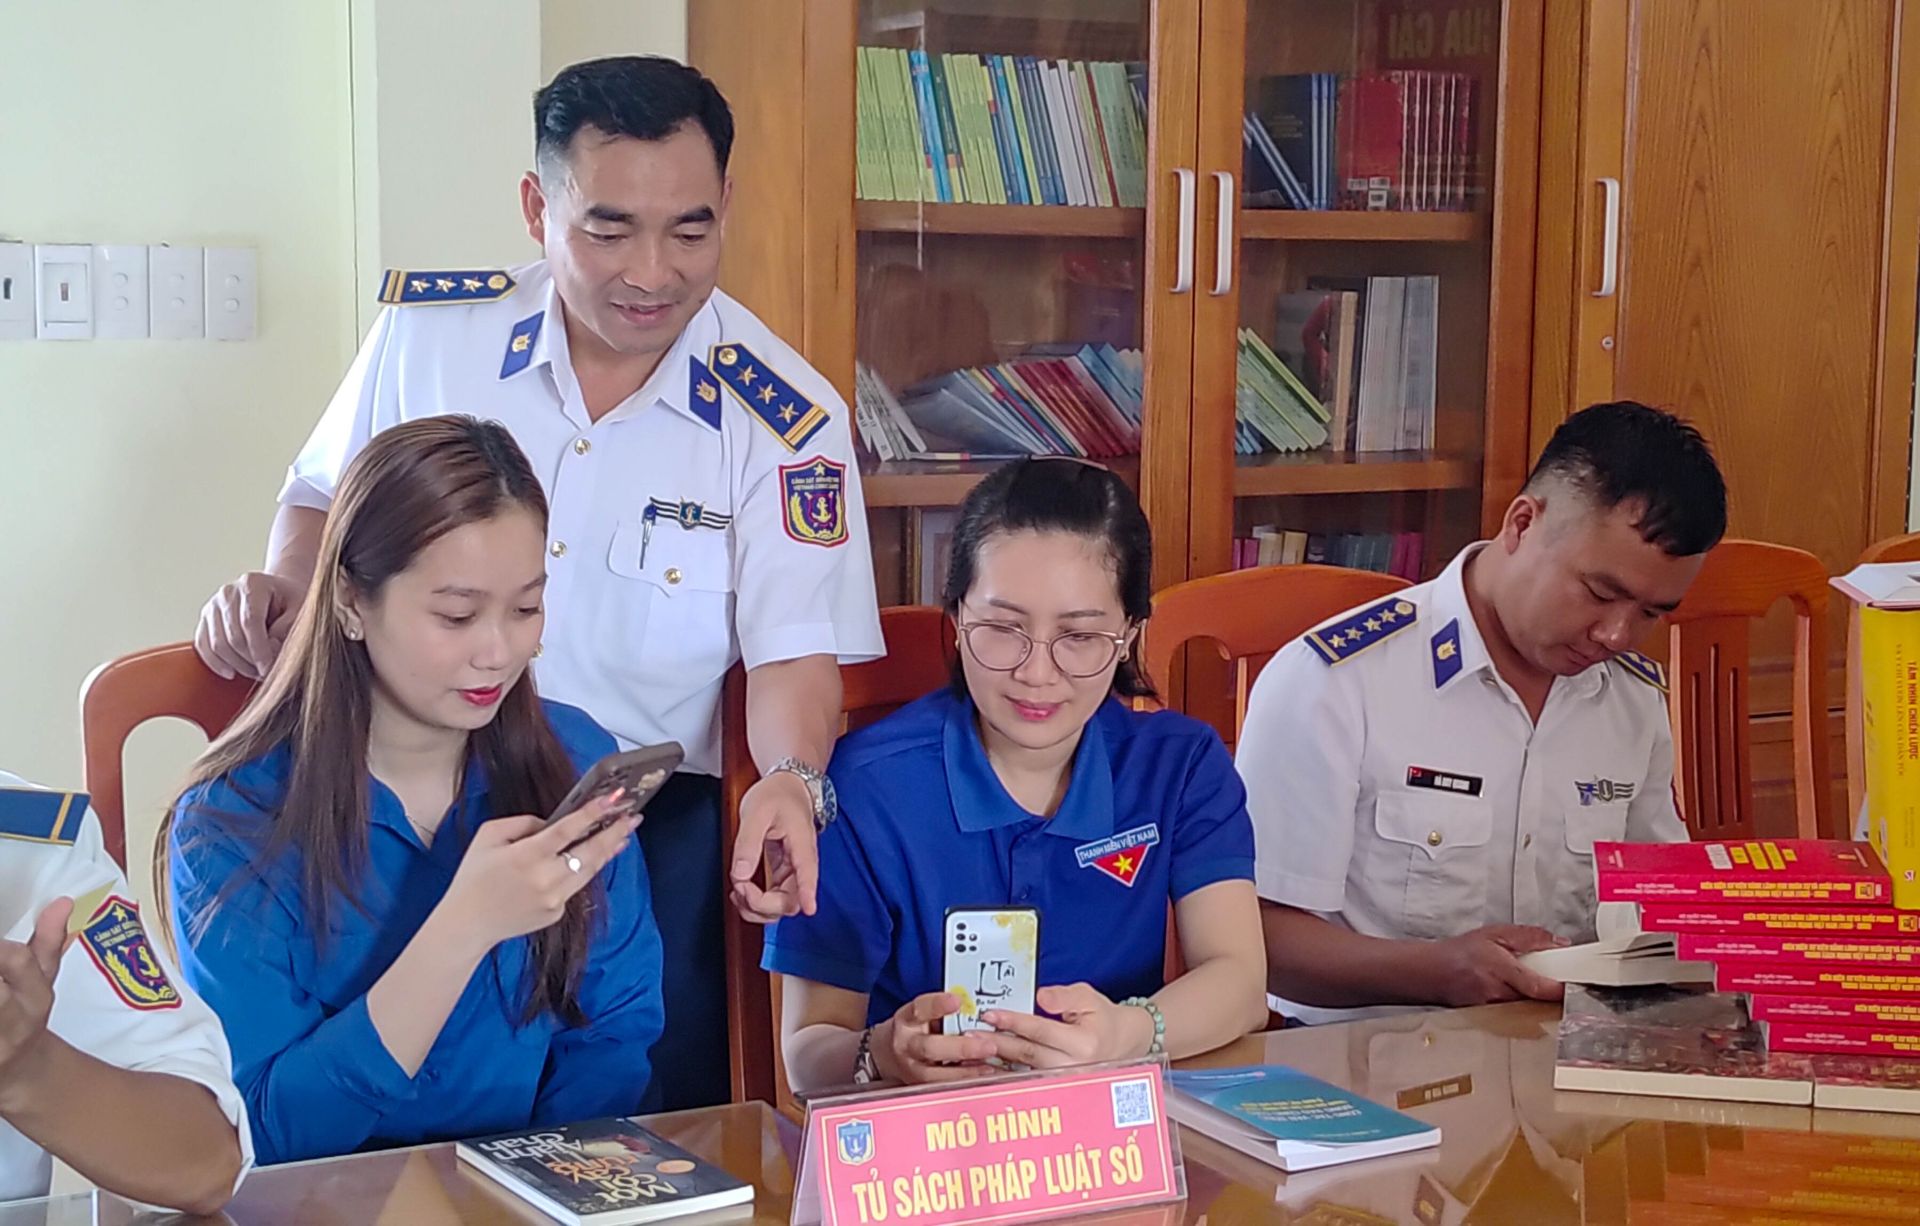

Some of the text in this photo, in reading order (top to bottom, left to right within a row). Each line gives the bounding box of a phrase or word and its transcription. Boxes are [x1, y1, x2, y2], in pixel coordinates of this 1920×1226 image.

[1137, 828, 1155, 842] NAM
[925, 1106, 1062, 1152] MÔ HÌNH
[851, 1129, 1144, 1223] TỦ SÁCH PHÁP LUẬT SỐ
